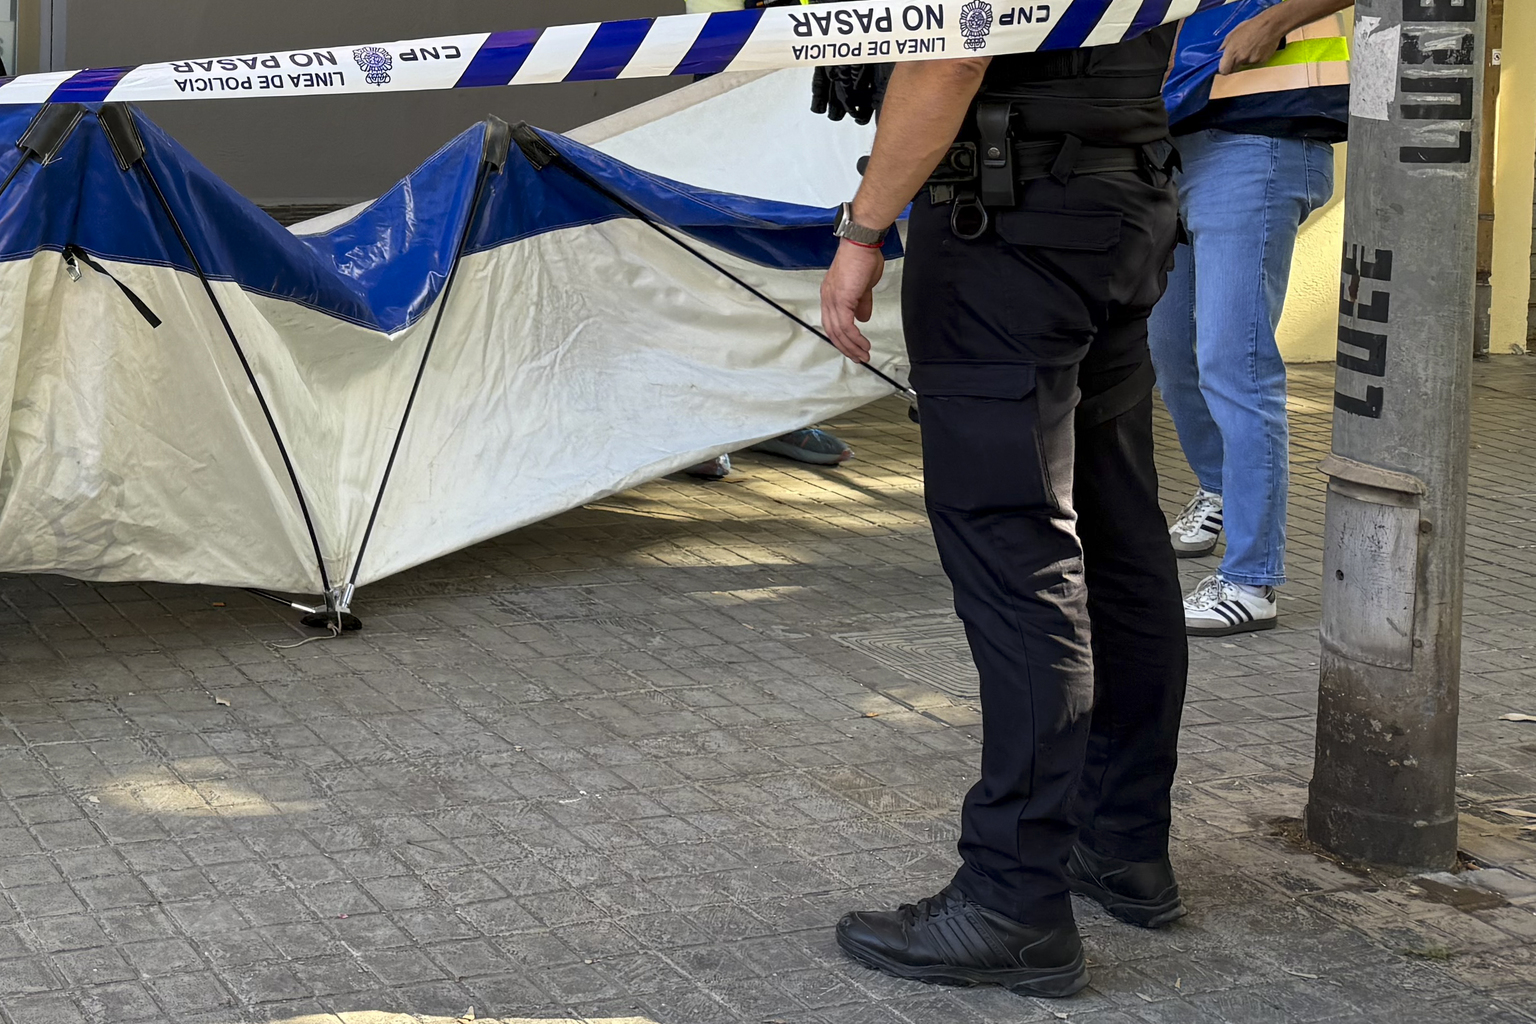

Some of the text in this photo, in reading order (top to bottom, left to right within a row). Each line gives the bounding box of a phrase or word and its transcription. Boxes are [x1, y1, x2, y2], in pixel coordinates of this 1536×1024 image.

[788, 4, 944, 38] NO PASAR
[999, 4, 1051, 26] CNP
[398, 44, 462, 62] CNP
[792, 37, 946, 60] LINEA DE POLICIA
[169, 50, 338, 74] NO PASAR
[174, 71, 346, 92] LINEA DE POLICIA
